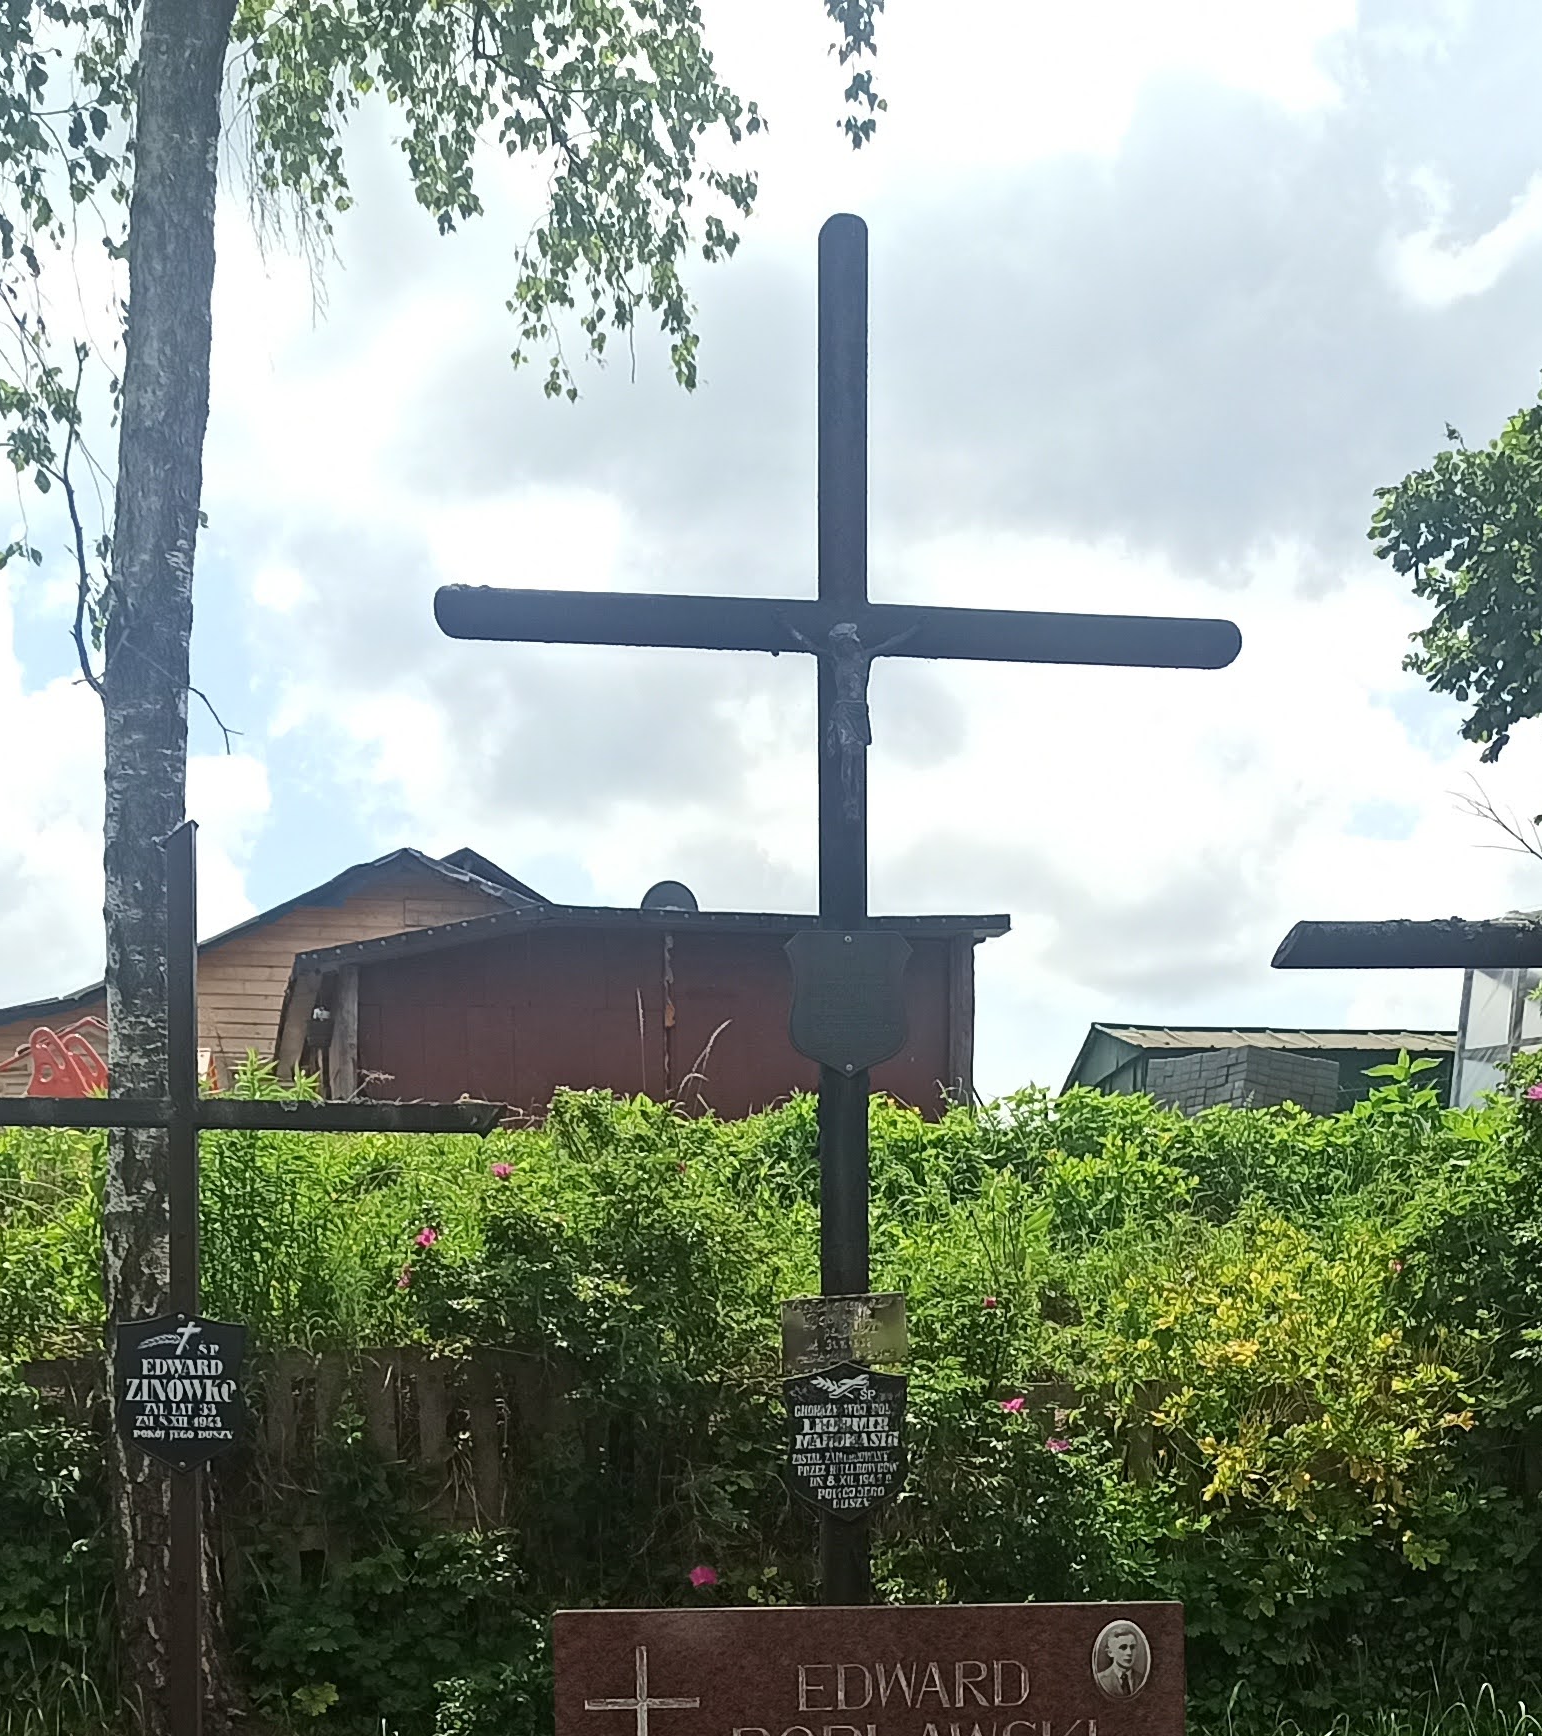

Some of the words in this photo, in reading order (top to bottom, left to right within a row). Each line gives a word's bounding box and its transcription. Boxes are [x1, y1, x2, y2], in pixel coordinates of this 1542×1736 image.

[142, 1359, 223, 1375] EDWARD
[171, 1404, 194, 1415] LAT
[169, 1430, 194, 1441] JEGO
[797, 1659, 1030, 1712] EDWARD
